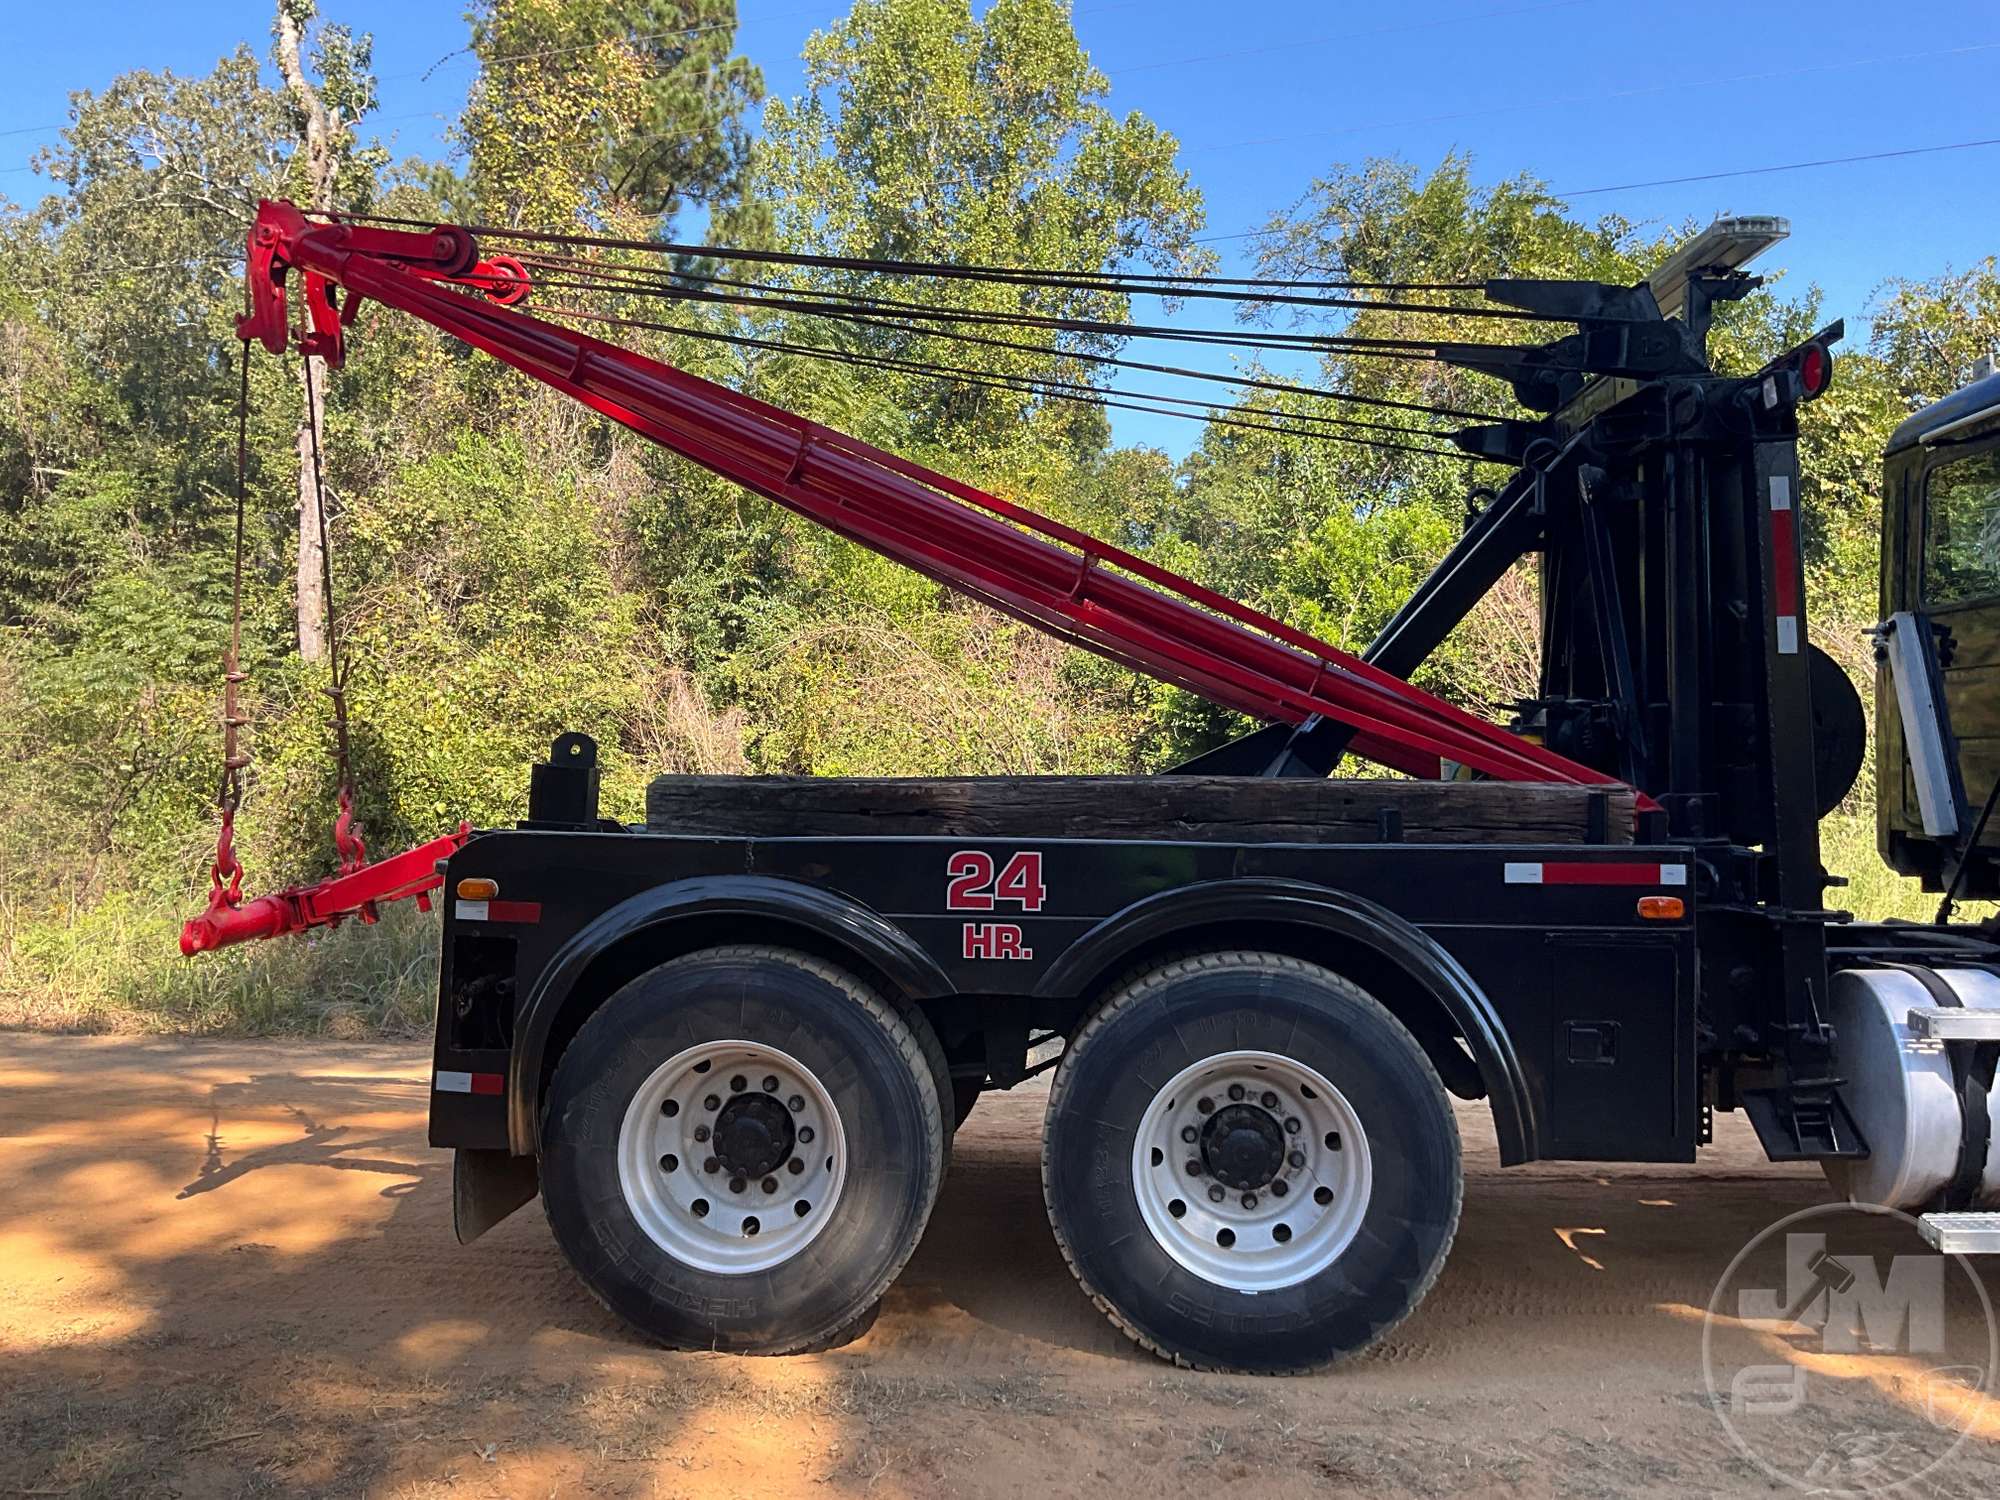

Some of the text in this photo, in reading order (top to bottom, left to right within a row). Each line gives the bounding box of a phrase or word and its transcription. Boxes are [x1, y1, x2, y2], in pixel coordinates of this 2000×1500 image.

[947, 851, 1046, 911] 24
[963, 923, 1033, 960] HR.
[591, 1217, 757, 1318] HERCULES
